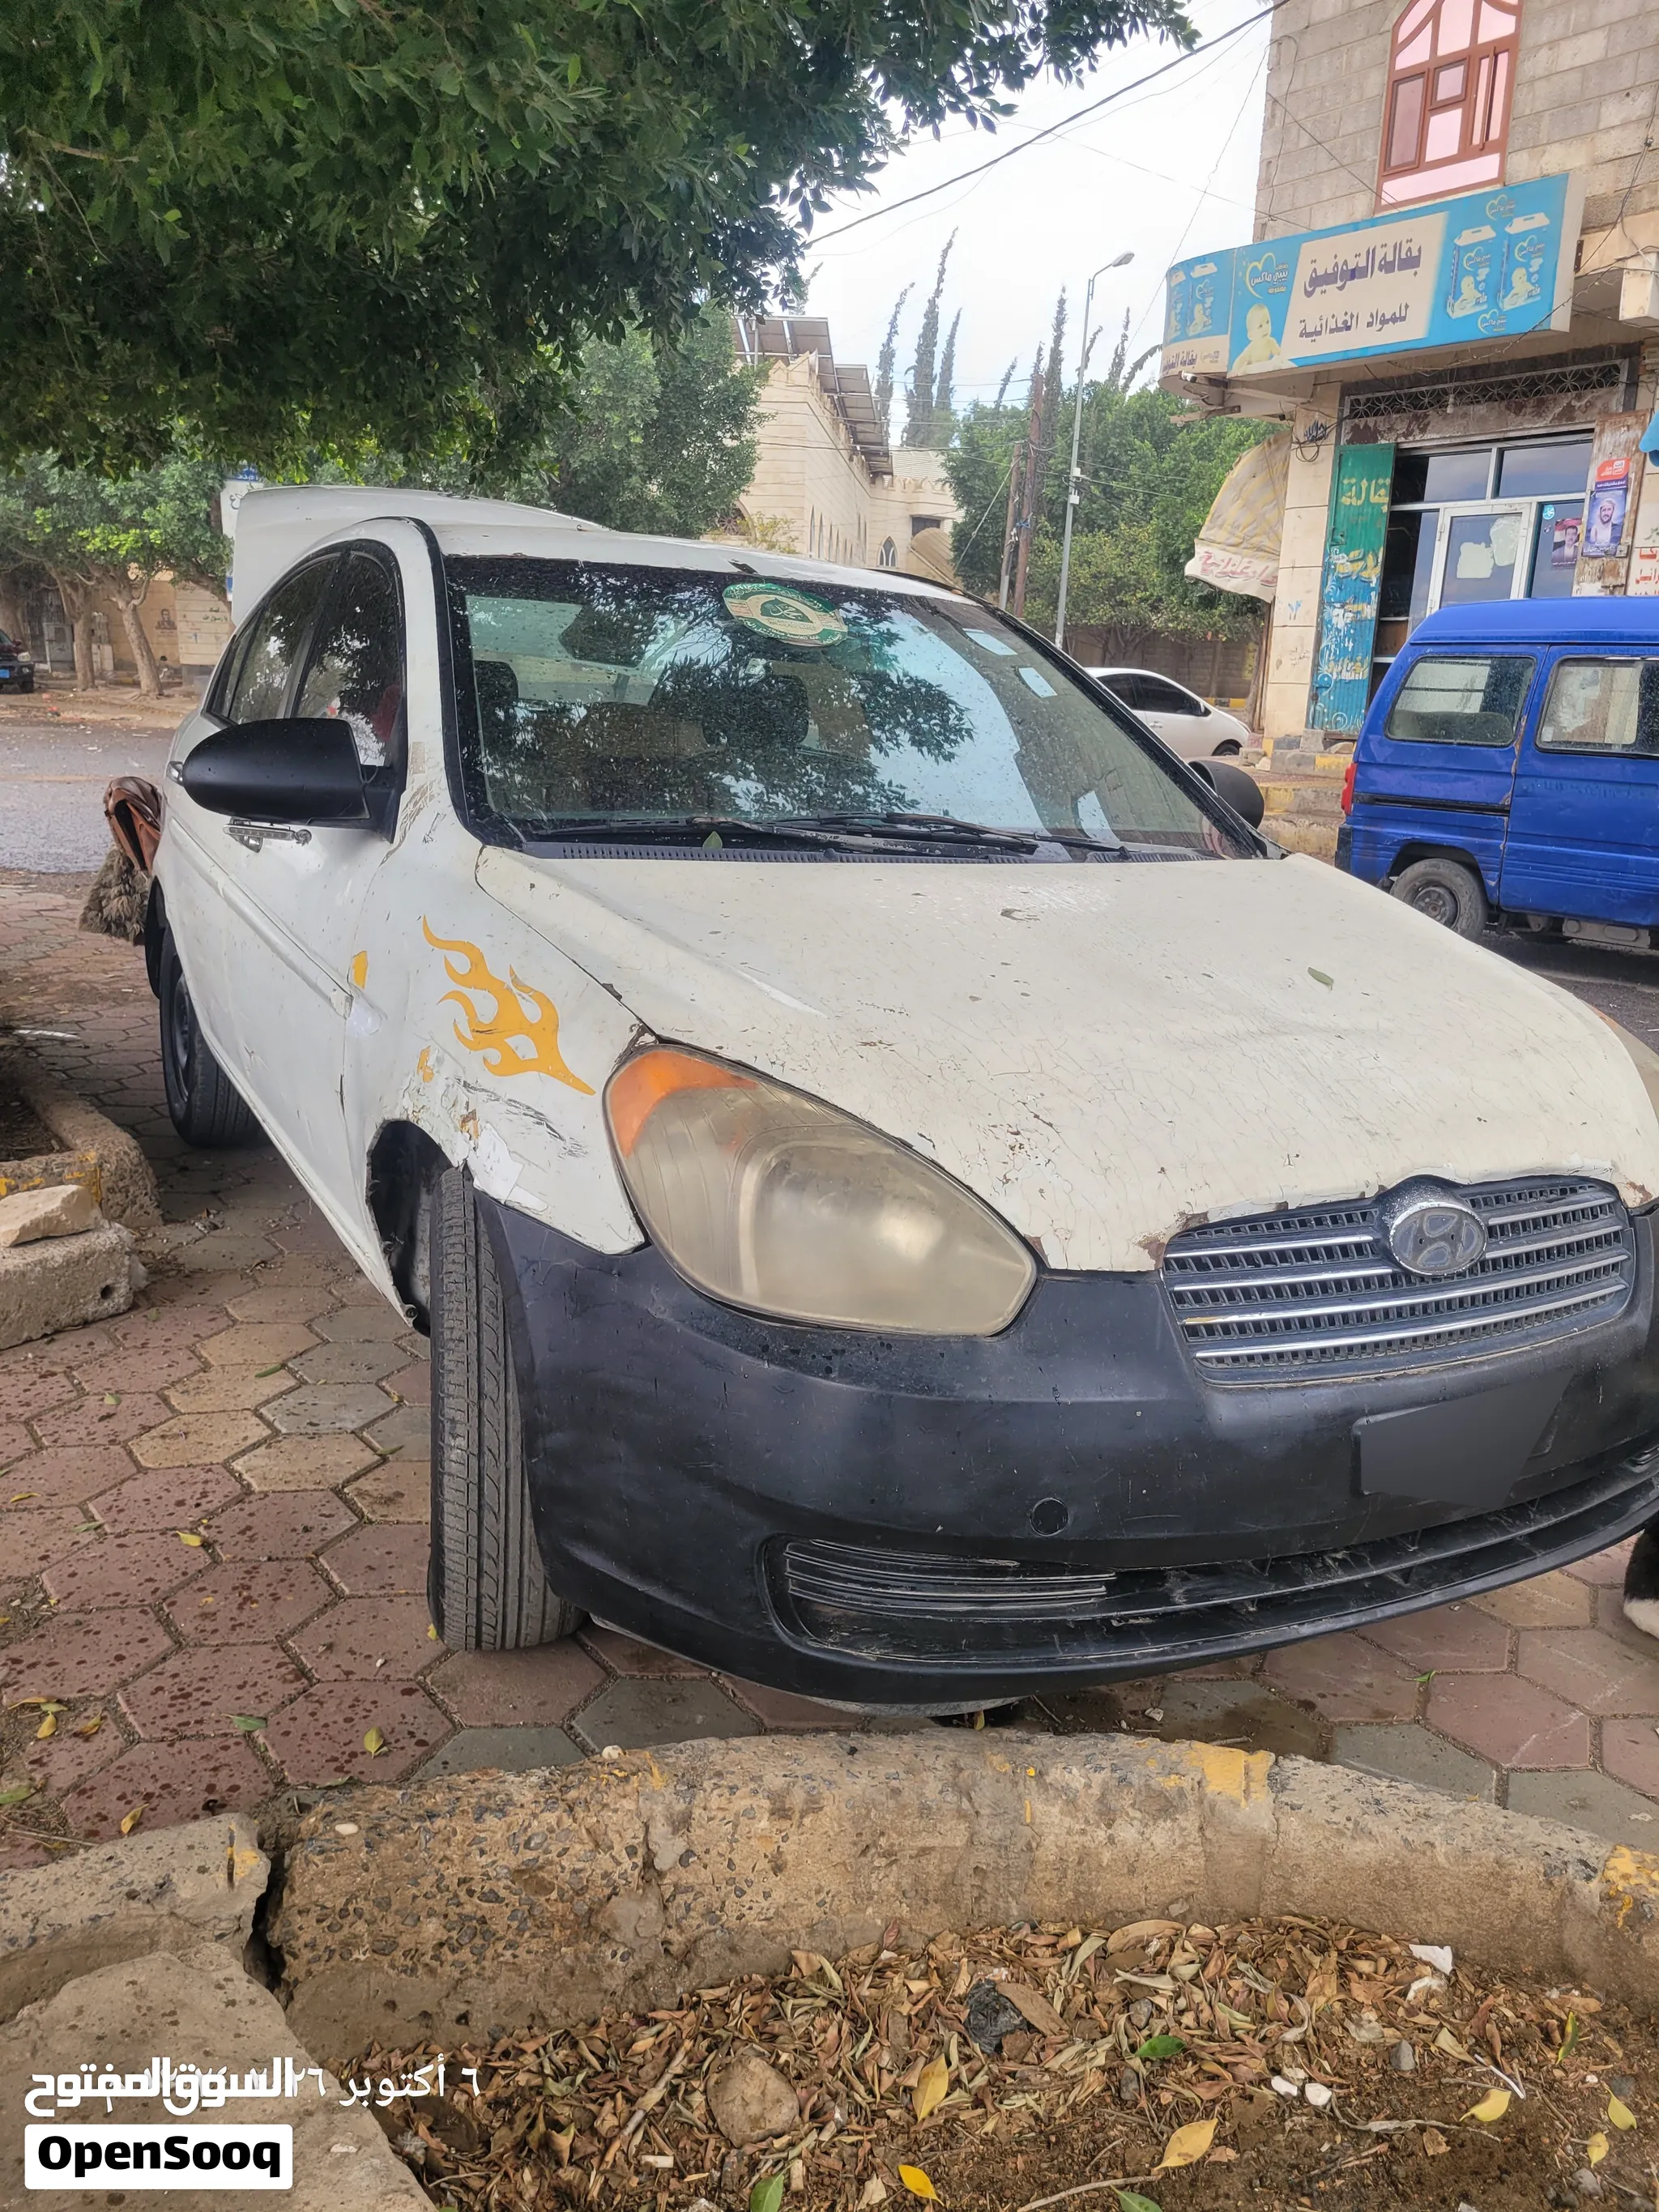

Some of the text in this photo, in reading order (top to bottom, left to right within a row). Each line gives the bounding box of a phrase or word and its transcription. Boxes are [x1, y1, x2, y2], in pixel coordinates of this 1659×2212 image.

[1251, 271, 1273, 287] ماكس
[1303, 238, 1422, 298] بقالة التوفيق
[1299, 302, 1410, 343] للمواد الغذائية
